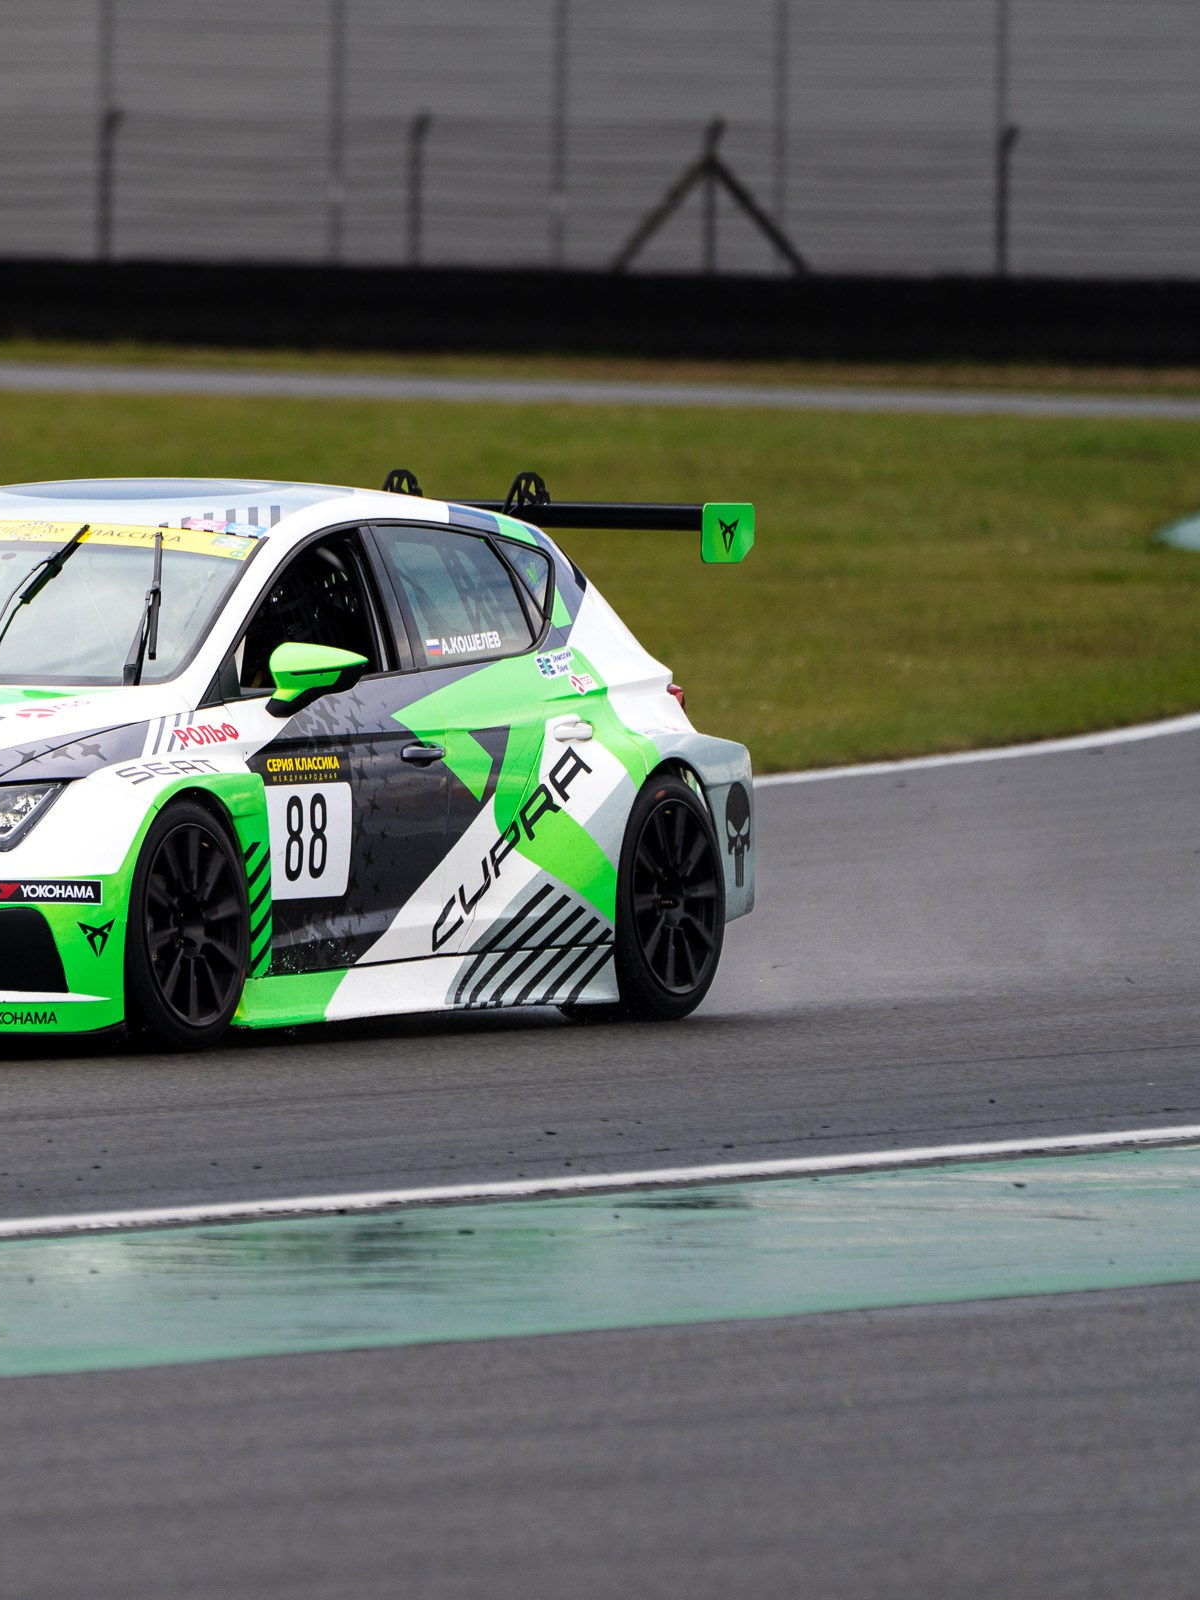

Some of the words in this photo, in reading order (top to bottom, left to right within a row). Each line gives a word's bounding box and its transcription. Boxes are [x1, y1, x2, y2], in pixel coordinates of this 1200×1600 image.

[441, 630, 502, 655] А.КОШЕЛЕВ
[173, 722, 240, 748] РОЛЬФ
[116, 759, 221, 785] SEAT
[266, 758, 295, 772] СЕРИЯ
[295, 755, 340, 771] КЛАССИКА
[272, 772, 338, 782] МЕЖДУНАРОДНАЯ
[285, 793, 328, 882] 88
[432, 746, 593, 952] CUPRA
[20, 884, 94, 899] YOKOHAMA
